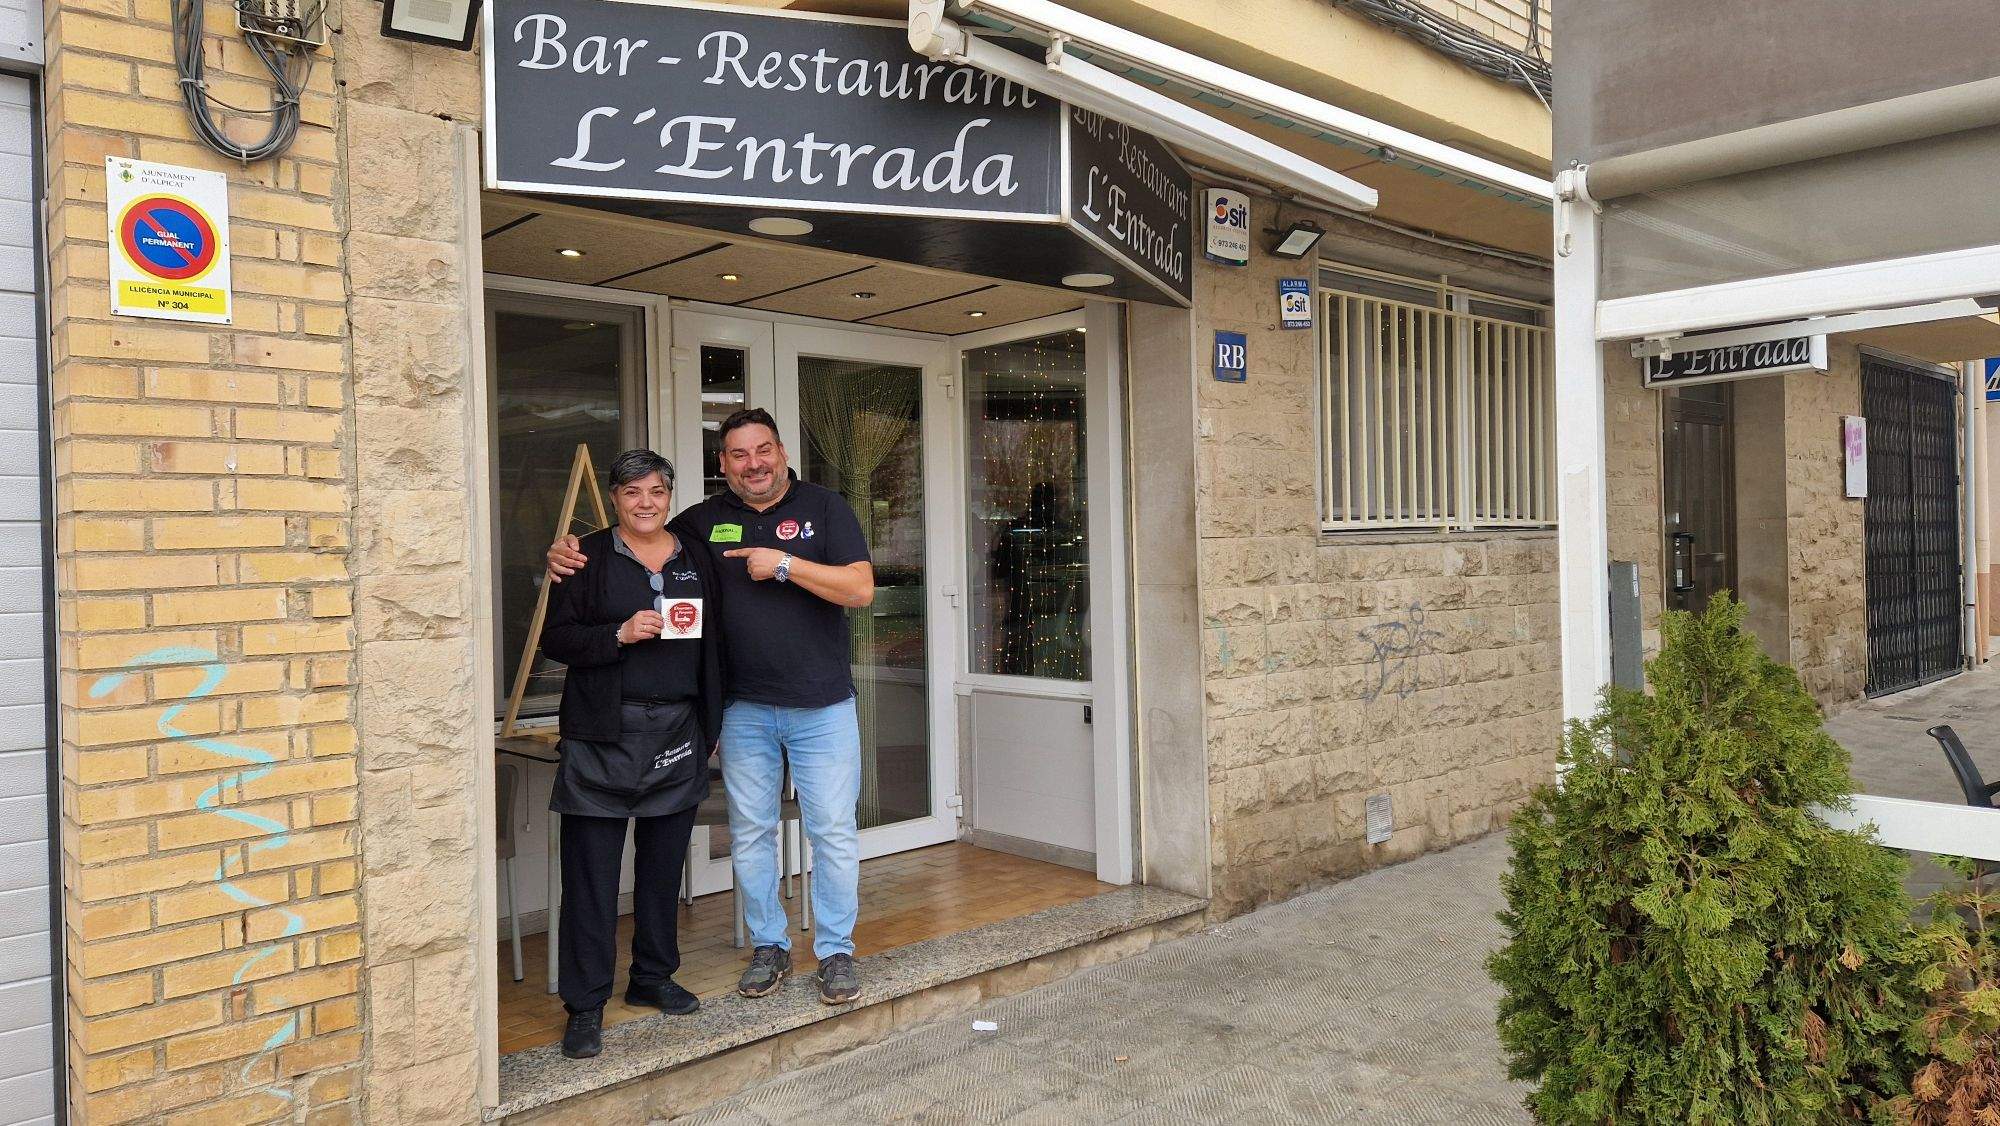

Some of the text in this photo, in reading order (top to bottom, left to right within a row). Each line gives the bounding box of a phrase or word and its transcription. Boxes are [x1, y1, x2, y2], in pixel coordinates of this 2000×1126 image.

[513, 13, 649, 77] Bar
[141, 169, 196, 182] AJUNTAMENT
[1117, 121, 1189, 221] Restaurant
[157, 230, 180, 240] GUAL
[142, 237, 195, 250] PERMANENT
[1282, 280, 1307, 288] ALARMA
[172, 289, 214, 300] MUNICIPAL
[171, 301, 189, 310] 304
[1218, 342, 1245, 370] RB
